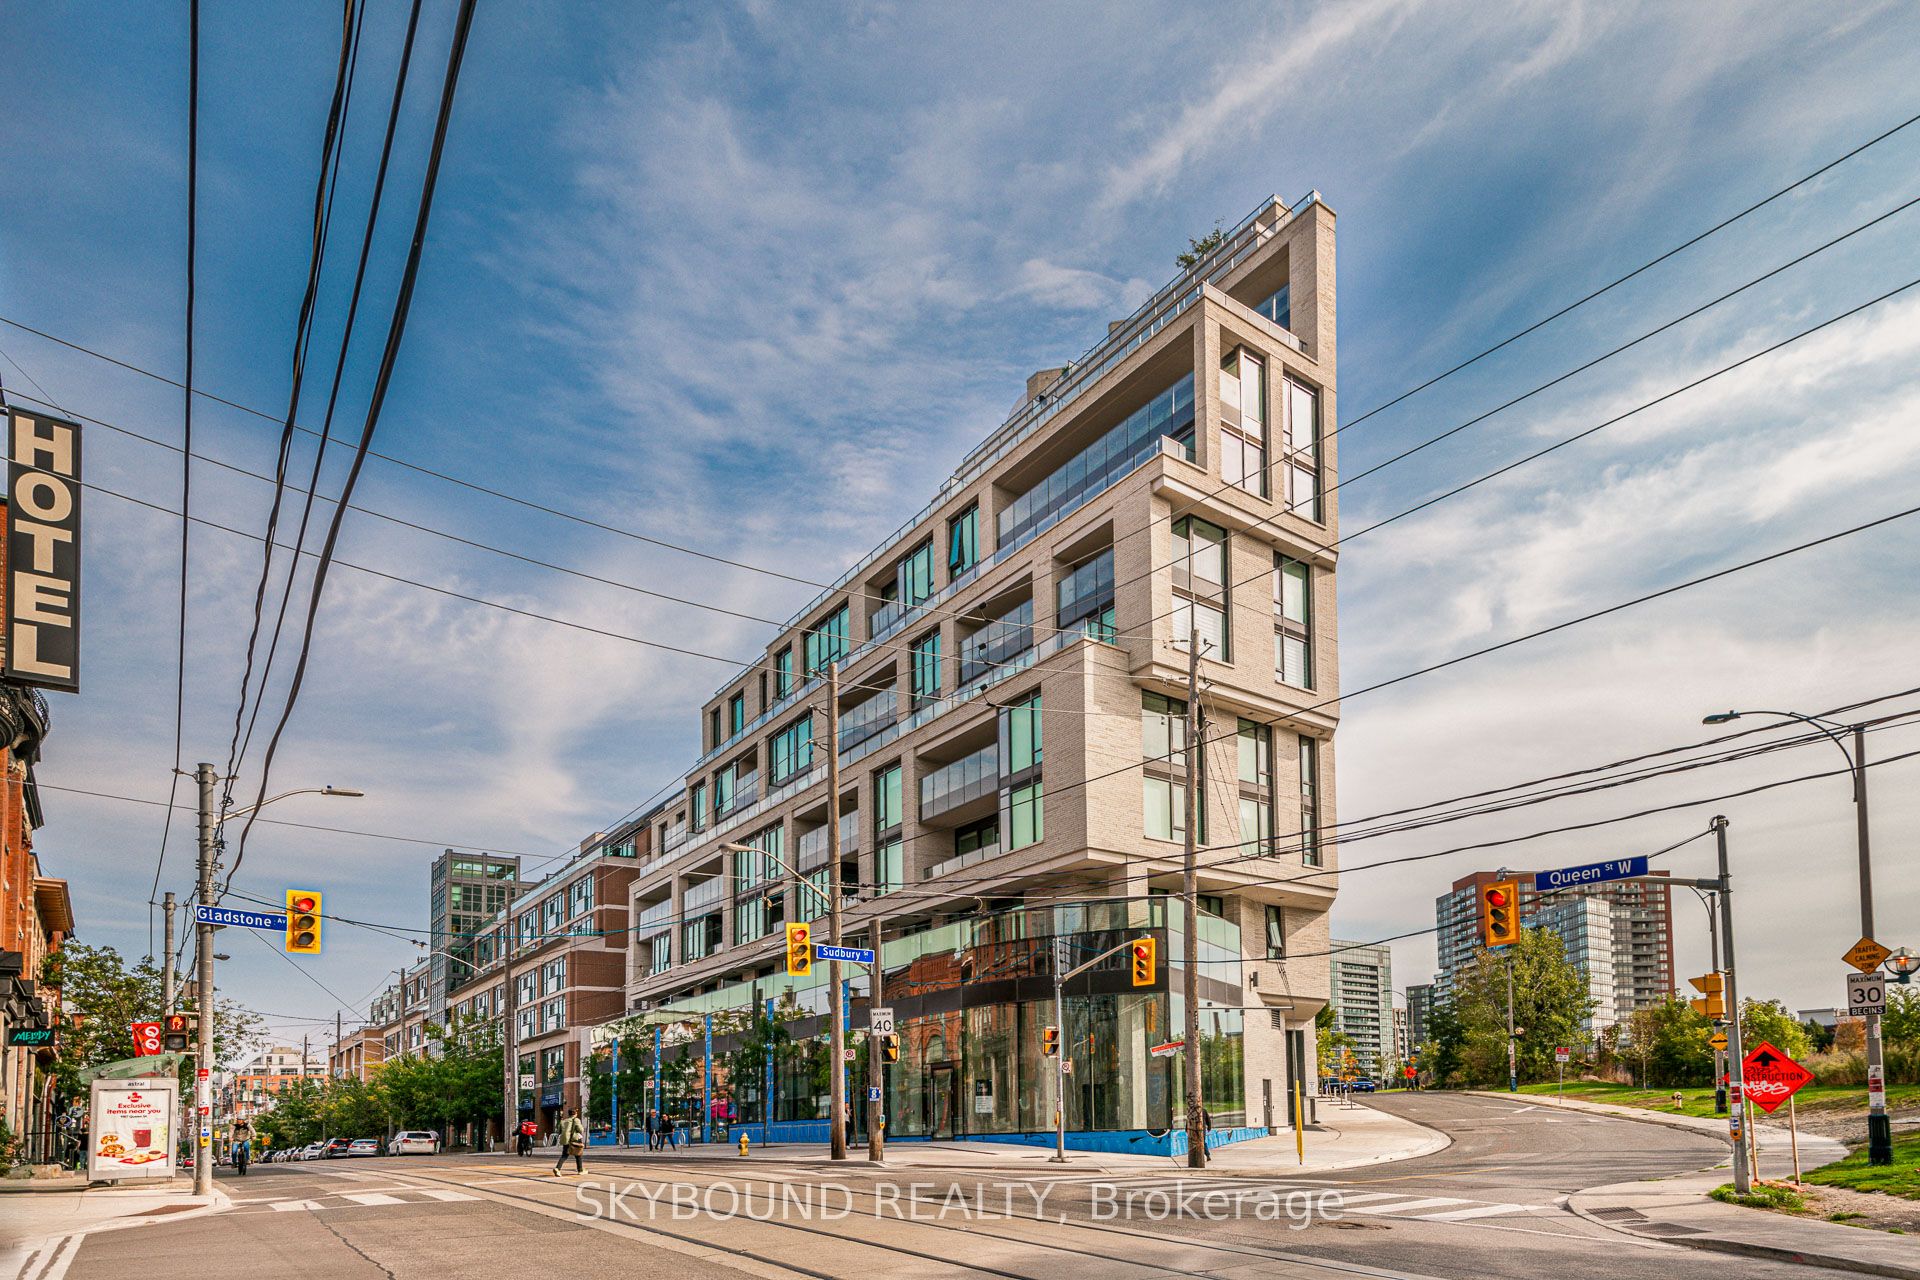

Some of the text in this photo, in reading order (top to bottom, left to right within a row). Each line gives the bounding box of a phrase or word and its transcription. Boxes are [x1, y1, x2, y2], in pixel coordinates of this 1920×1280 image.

[13, 414, 73, 680] HOTEL
[1549, 860, 1632, 885] Queen St W
[197, 907, 272, 927] Gladstone
[823, 946, 861, 961] Sudbury
[1855, 944, 1878, 954] TRAFFIC
[1854, 952, 1881, 962] CALMING
[1861, 961, 1876, 970] ZONE
[1850, 975, 1882, 984] MAXIMUM
[1853, 987, 1881, 1004] 30
[1852, 1006, 1883, 1015] BEGINS
[873, 1020, 892, 1032] 40
[13, 1030, 51, 1042] MELODY
[522, 1080, 534, 1088] 40
